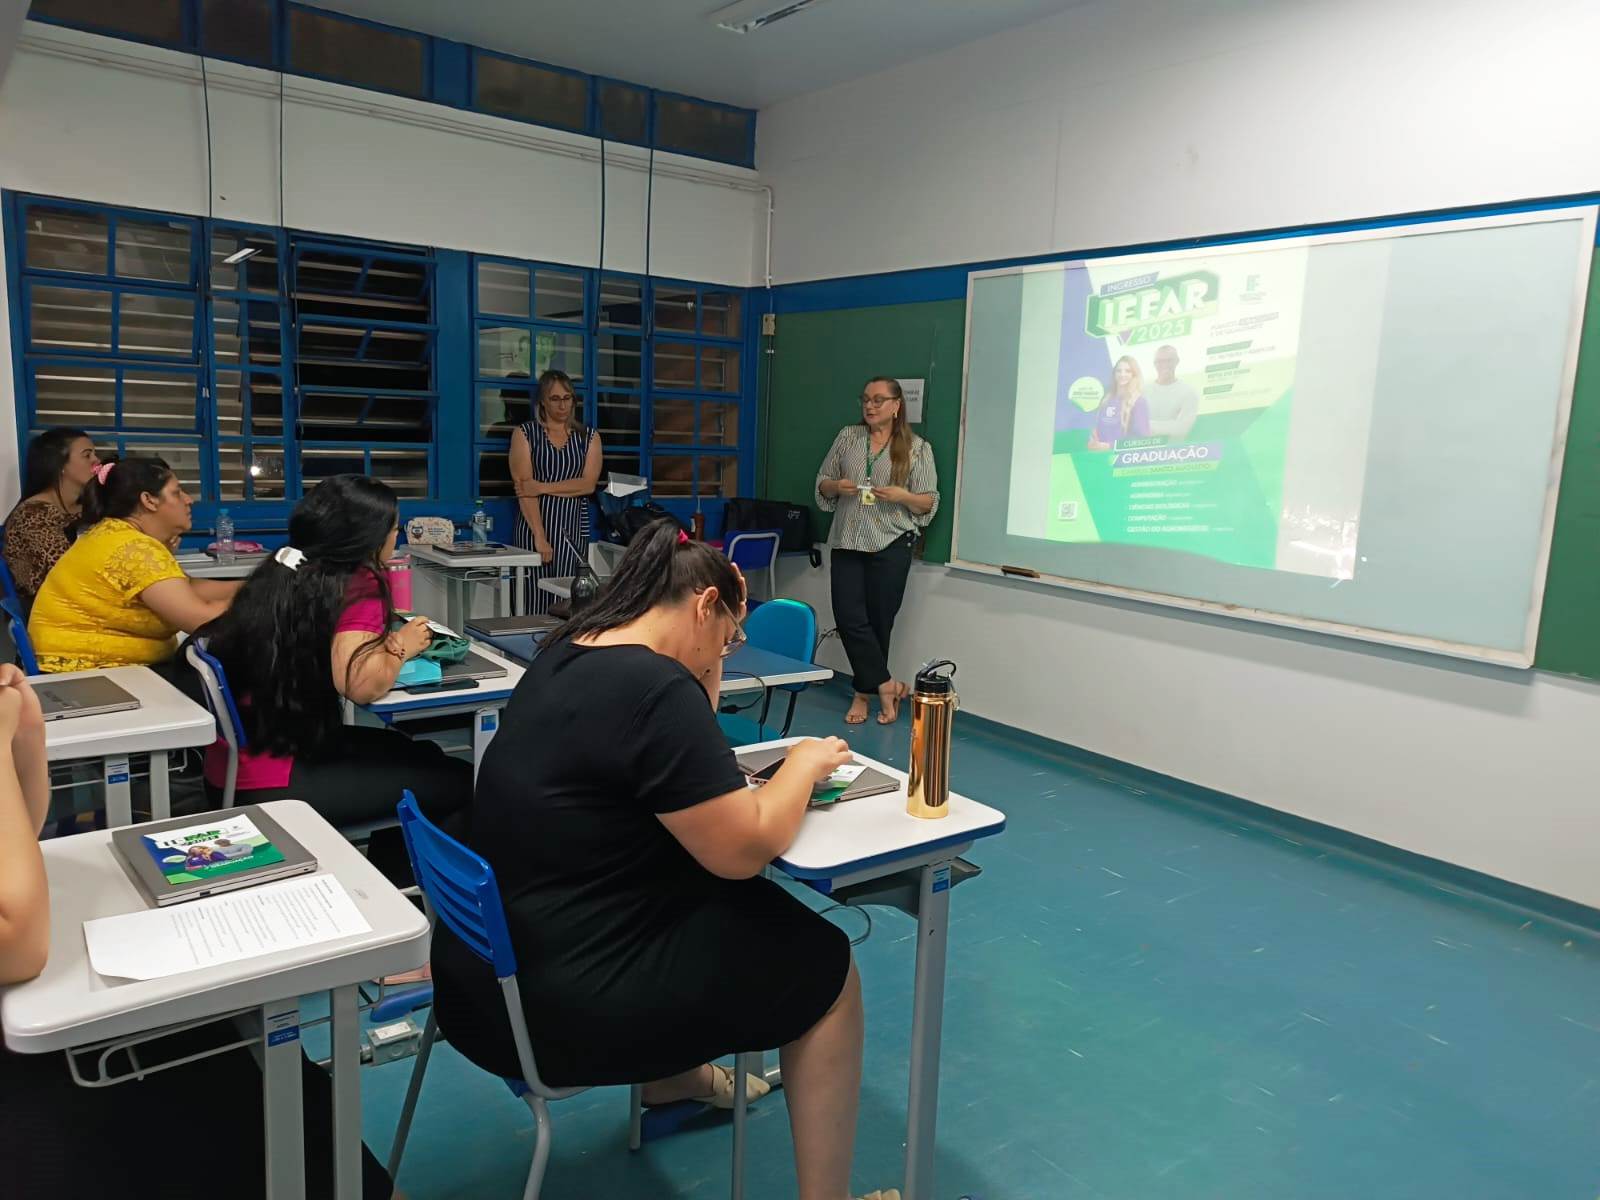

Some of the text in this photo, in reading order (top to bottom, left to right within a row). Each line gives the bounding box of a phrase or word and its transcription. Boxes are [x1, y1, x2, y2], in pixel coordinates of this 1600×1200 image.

[1106, 276, 1152, 293] INGRESSO
[1136, 319, 1186, 342] 2025
[1121, 444, 1209, 464] GRADUAÇÃO
